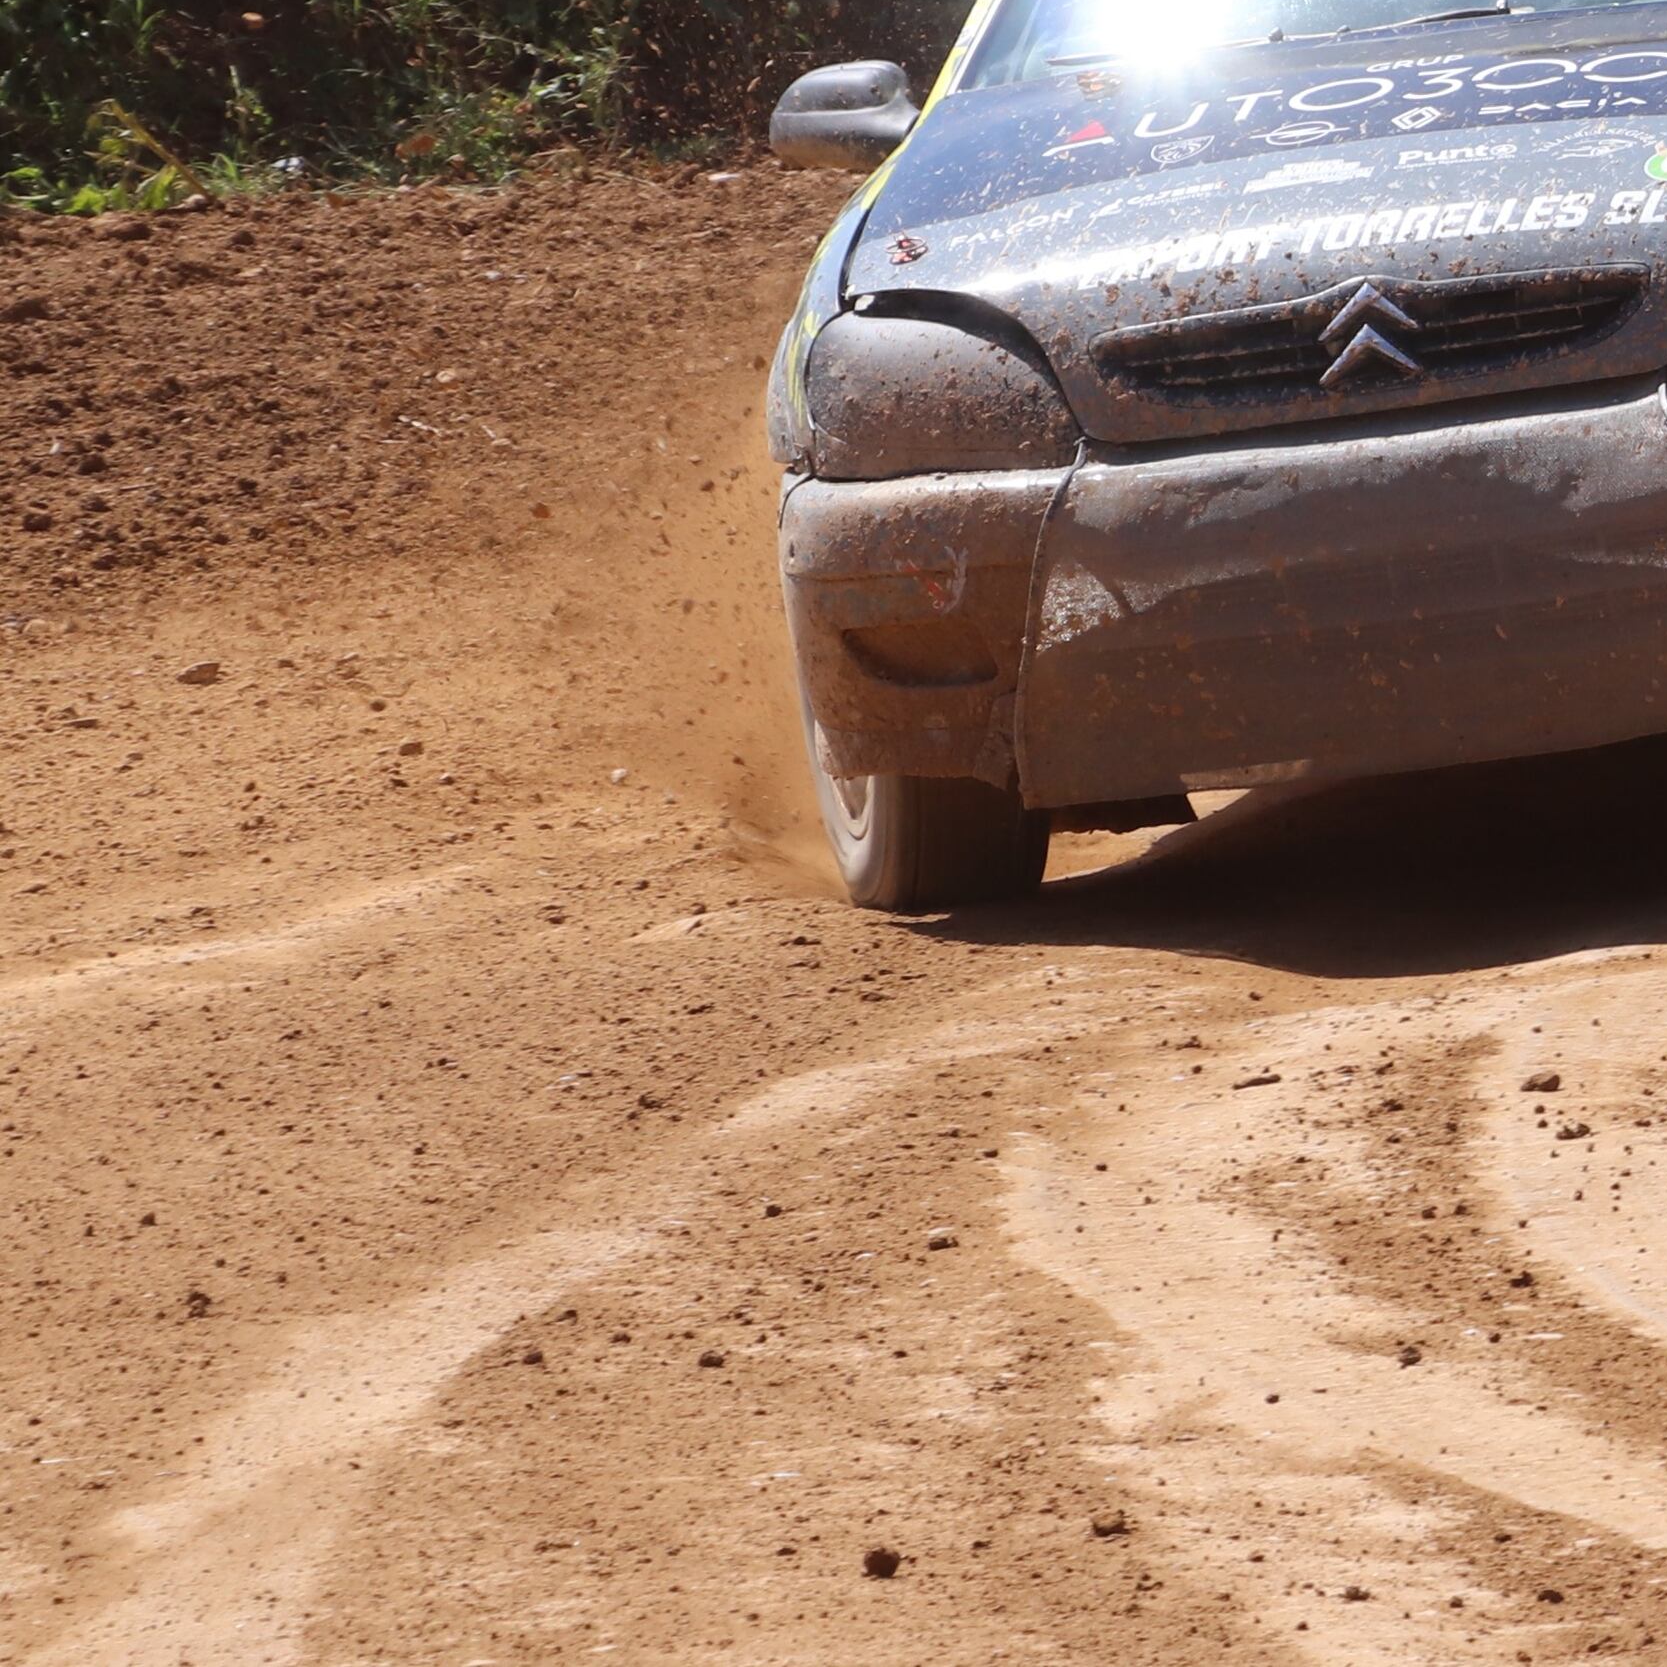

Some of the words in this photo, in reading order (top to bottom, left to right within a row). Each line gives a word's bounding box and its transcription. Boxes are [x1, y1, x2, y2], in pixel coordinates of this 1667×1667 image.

[1366, 54, 1465, 73] GRUP
[1078, 226, 1282, 289] EXPORT
[1299, 193, 1591, 254] TORRELLES
